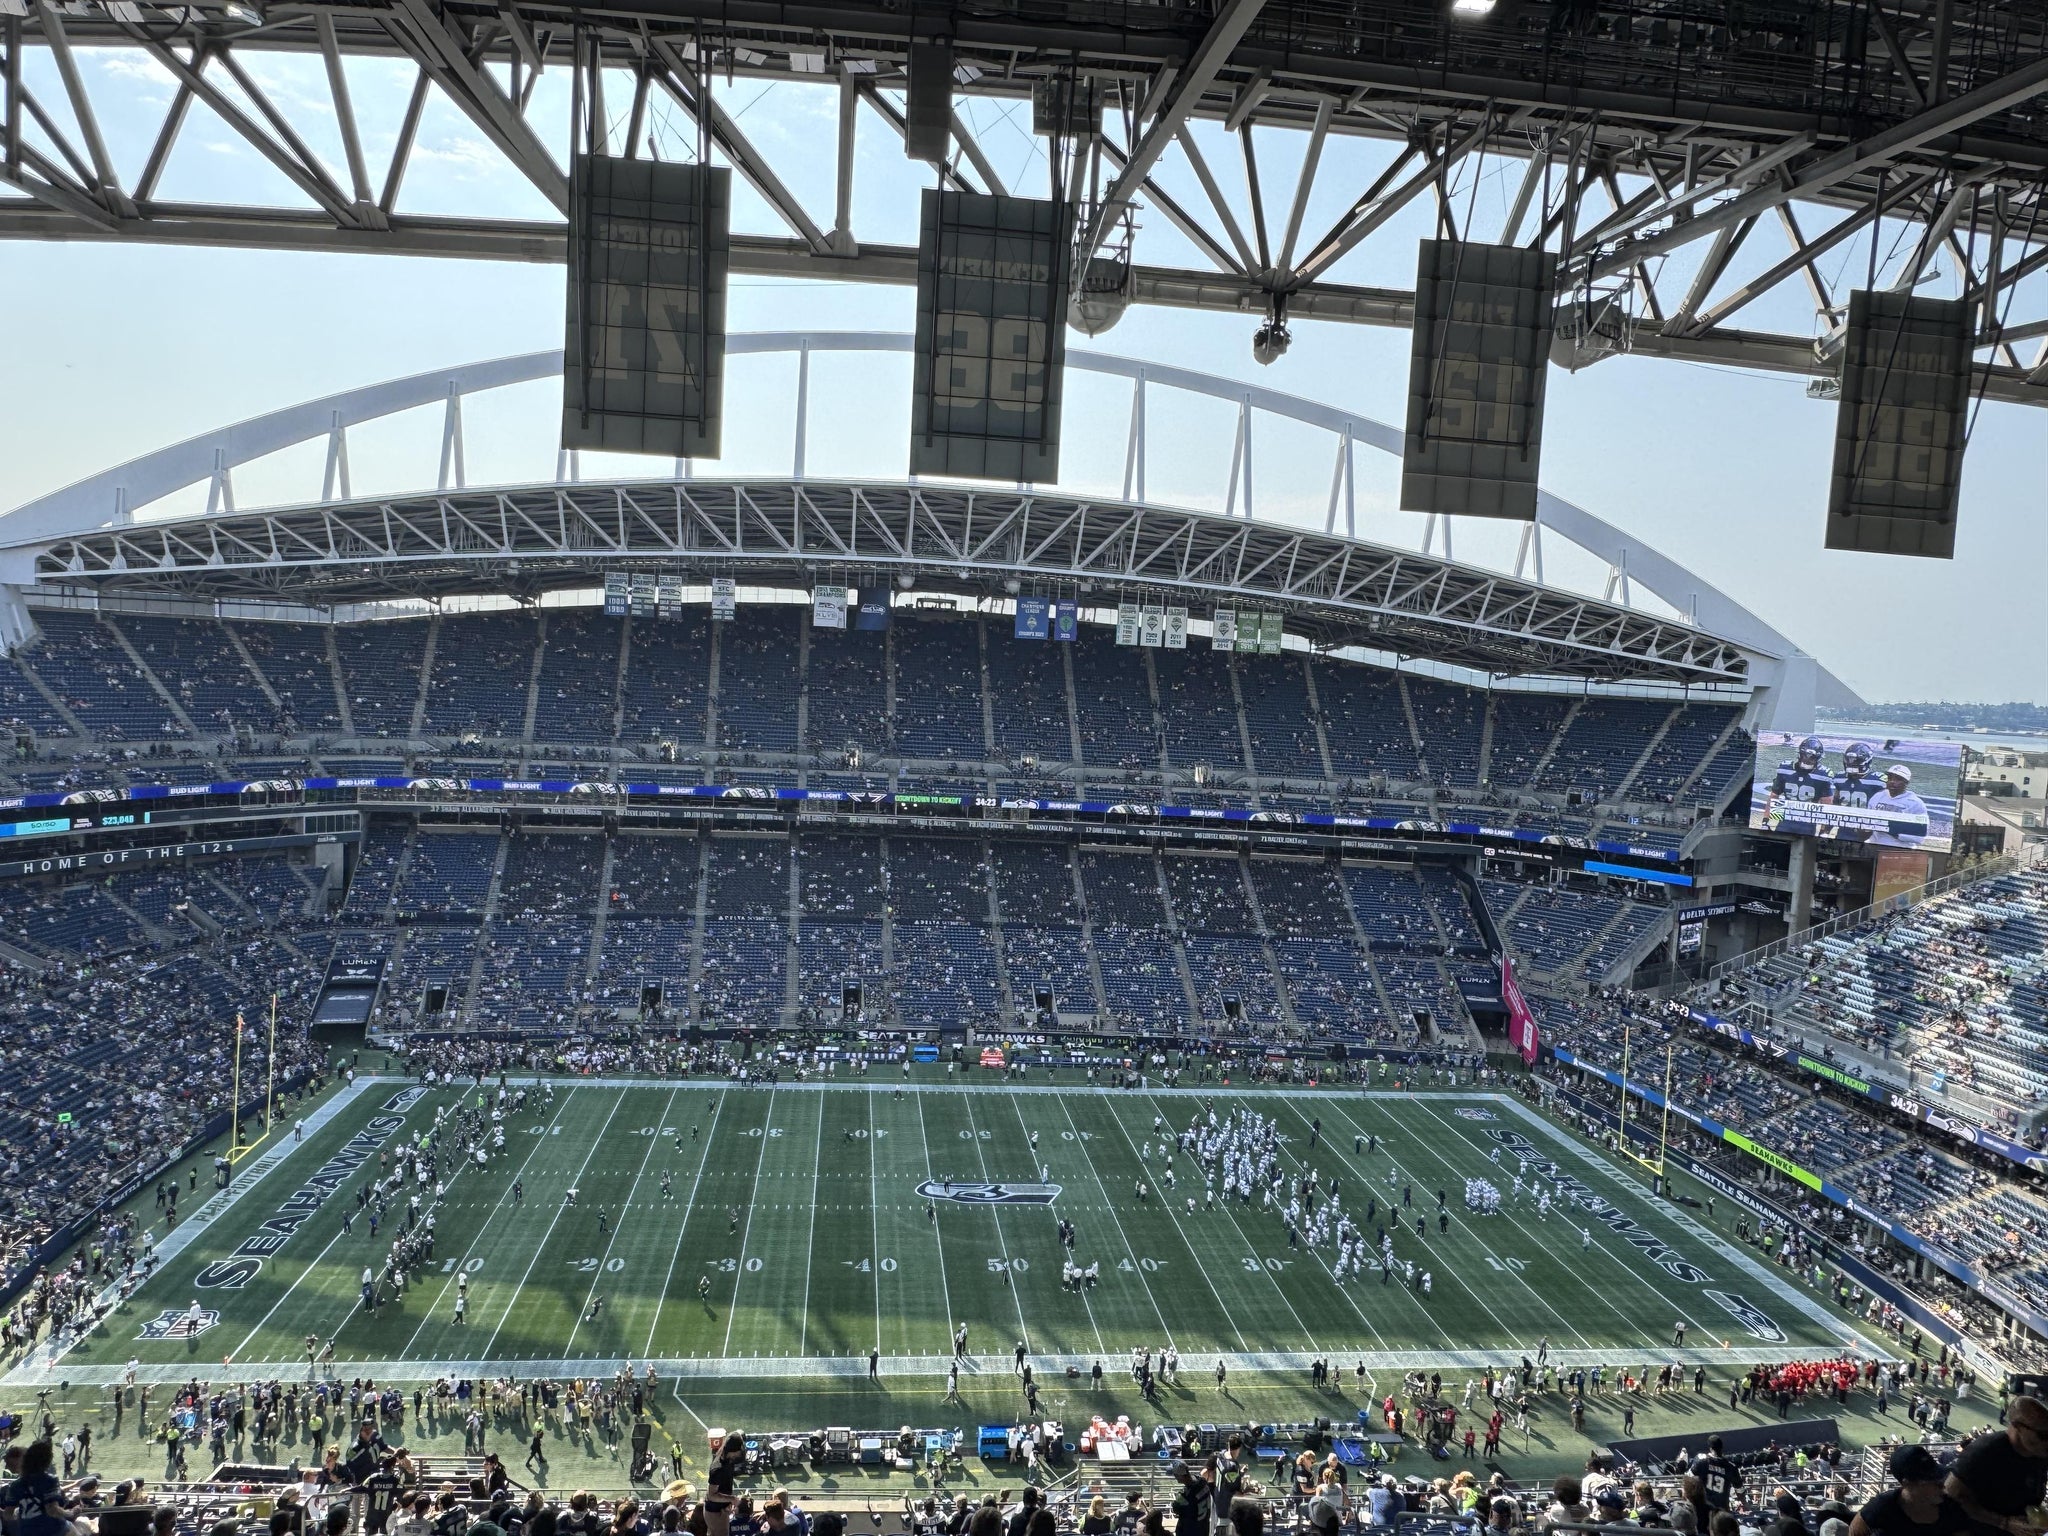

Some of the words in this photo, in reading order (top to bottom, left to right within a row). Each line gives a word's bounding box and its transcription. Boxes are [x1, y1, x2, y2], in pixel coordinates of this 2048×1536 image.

[170, 787, 186, 795] BUD
[187, 786, 211, 794] LIGHT
[504, 782, 519, 790] BUD
[675, 787, 696, 795] LIGHT
[0, 799, 25, 808] LIGHT
[895, 795, 930, 803] COUNTDOWN
[938, 796, 962, 804] KICKOFF
[975, 797, 997, 807] 34:23
[1062, 802, 1082, 810] LIGHT
[1806, 803, 1824, 812] LOVE
[1494, 829, 1514, 837] LIGHT
[24, 856, 87, 874] HOME
[103, 851, 129, 864] OF
[146, 846, 184, 859] THE
[201, 843, 233, 853] 12s
[1644, 849, 1666, 858] LIGHT
[1686, 909, 1706, 919] DELTA
[1668, 999, 1690, 1018] 34:23
[857, 1030, 927, 1040] SEATLE
[1798, 1056, 1835, 1080] COUNTDOWN
[1835, 1071, 1845, 1083] TO
[1844, 1076, 1871, 1094] KICKOFF
[1890, 1093, 1919, 1116] 34:23
[1750, 1144, 1794, 1174] SEAHAWKS
[232, 1155, 284, 1195] FOOTBALL
[1690, 1162, 1735, 1195] SEATTLE
[194, 1115, 406, 1289] SEAHAWKS
[1480, 1129, 1716, 1283] SEAHAWKS
[1673, 1214, 1699, 1229] OF
[441, 1257, 486, 1273] 10
[579, 1257, 626, 1273] 20
[720, 1257, 764, 1273] 30
[853, 1257, 899, 1273] 40
[988, 1257, 1030, 1273] 50
[1117, 1257, 1161, 1273] 40
[1241, 1257, 1284, 1272] 30
[1484, 1256, 1526, 1272] 10
[1707, 1473, 1726, 1494] 13
[375, 1490, 389, 1511] 11
